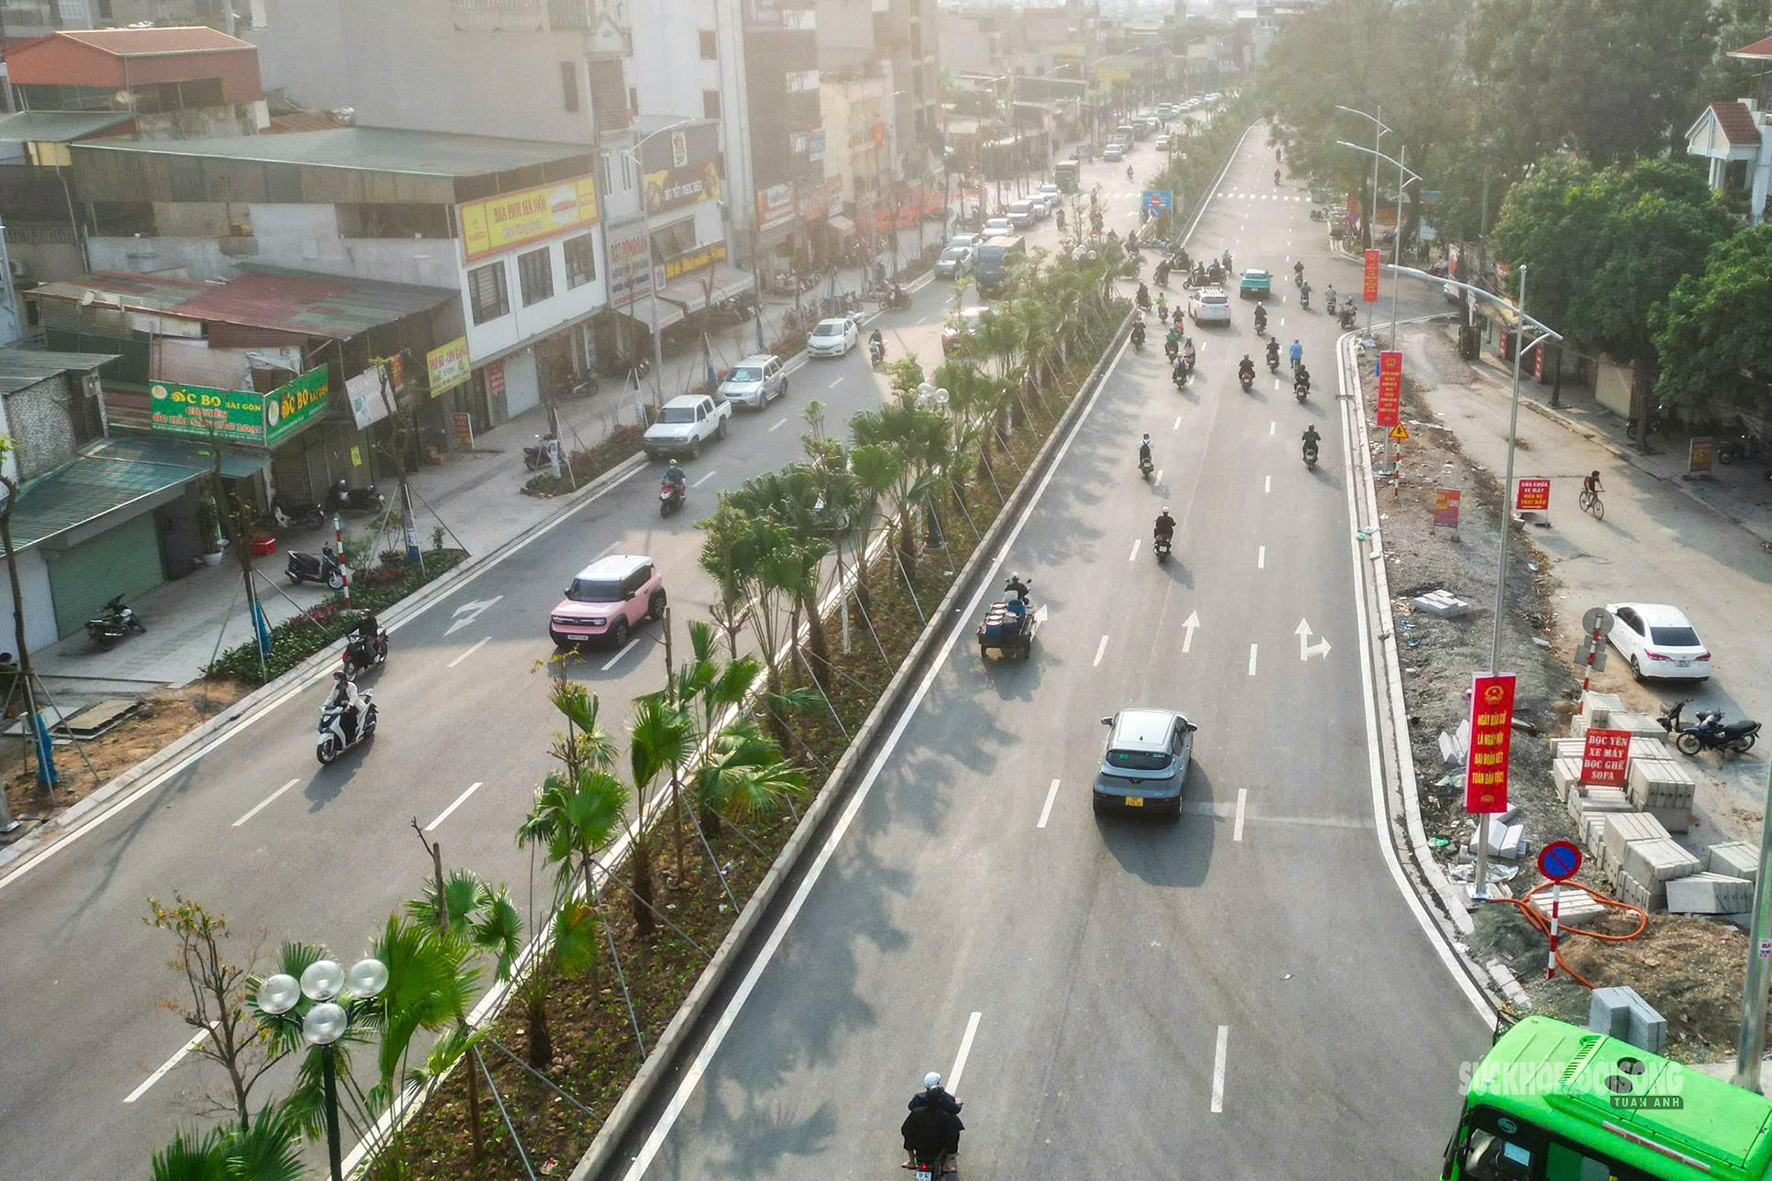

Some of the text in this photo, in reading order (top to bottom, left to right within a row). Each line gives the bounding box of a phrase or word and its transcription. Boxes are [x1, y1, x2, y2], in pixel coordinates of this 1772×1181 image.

[1589, 735, 1628, 746] BỌC YÊN
[1589, 747, 1624, 758] XE MÁY
[1583, 759, 1625, 770] BỌC GHẾ
[1591, 770, 1614, 780] SOFA
